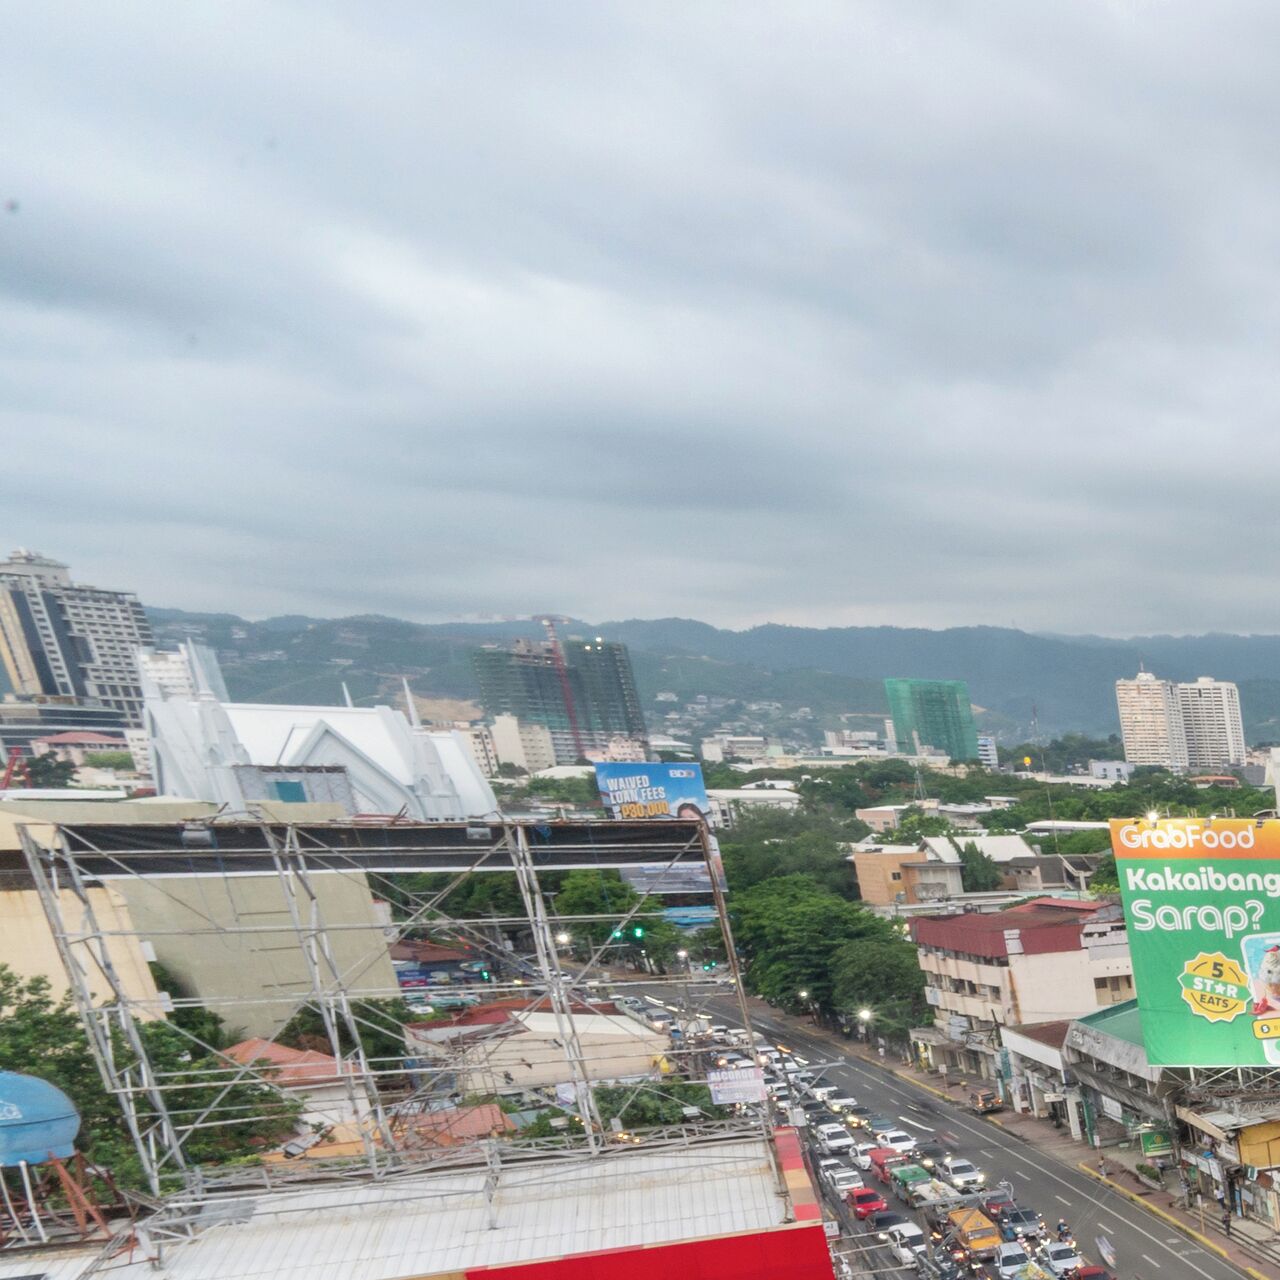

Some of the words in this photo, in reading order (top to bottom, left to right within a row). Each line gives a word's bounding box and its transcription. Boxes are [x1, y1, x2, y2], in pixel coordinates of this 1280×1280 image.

[607, 776, 650, 790] WAIVED
[609, 789, 638, 804] LOAN
[641, 786, 666, 800] FEES
[1119, 824, 1255, 849] GrabFood
[1131, 899, 1265, 938] Sarap?
[1212, 962, 1224, 978] 5
[1200, 994, 1229, 1008] EATS
